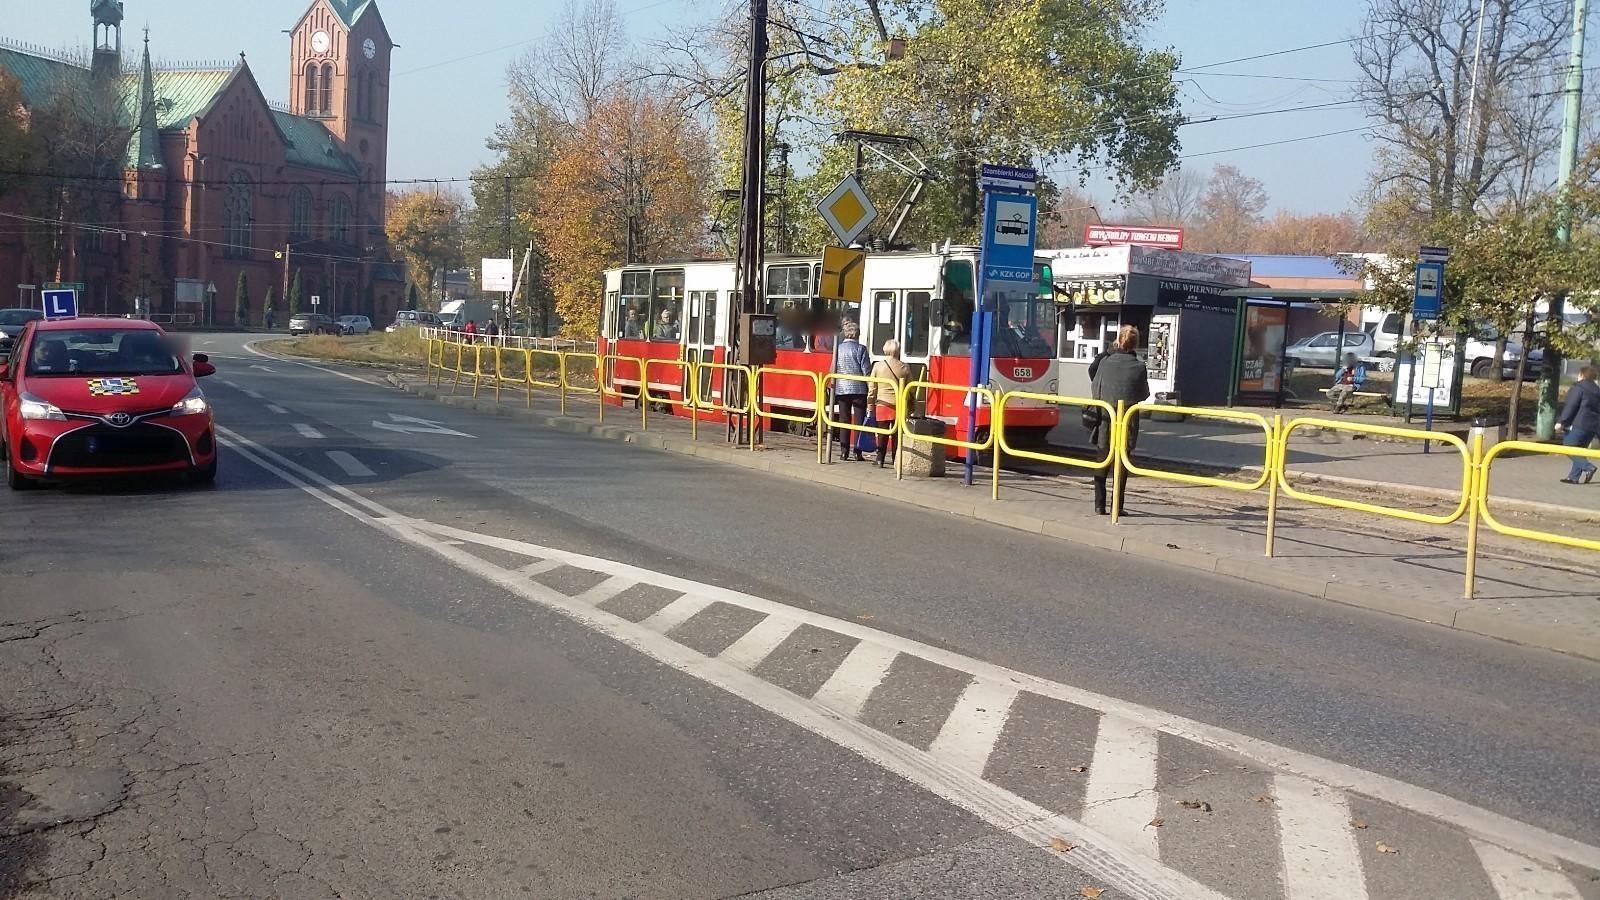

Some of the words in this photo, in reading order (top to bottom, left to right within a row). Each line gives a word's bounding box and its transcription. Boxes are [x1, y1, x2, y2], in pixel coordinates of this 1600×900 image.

[1000, 270, 1014, 278] KZK
[1015, 271, 1030, 279] GOP
[1160, 281, 1181, 290] TANIE
[53, 295, 67, 313] L
[1014, 368, 1031, 377] 658
